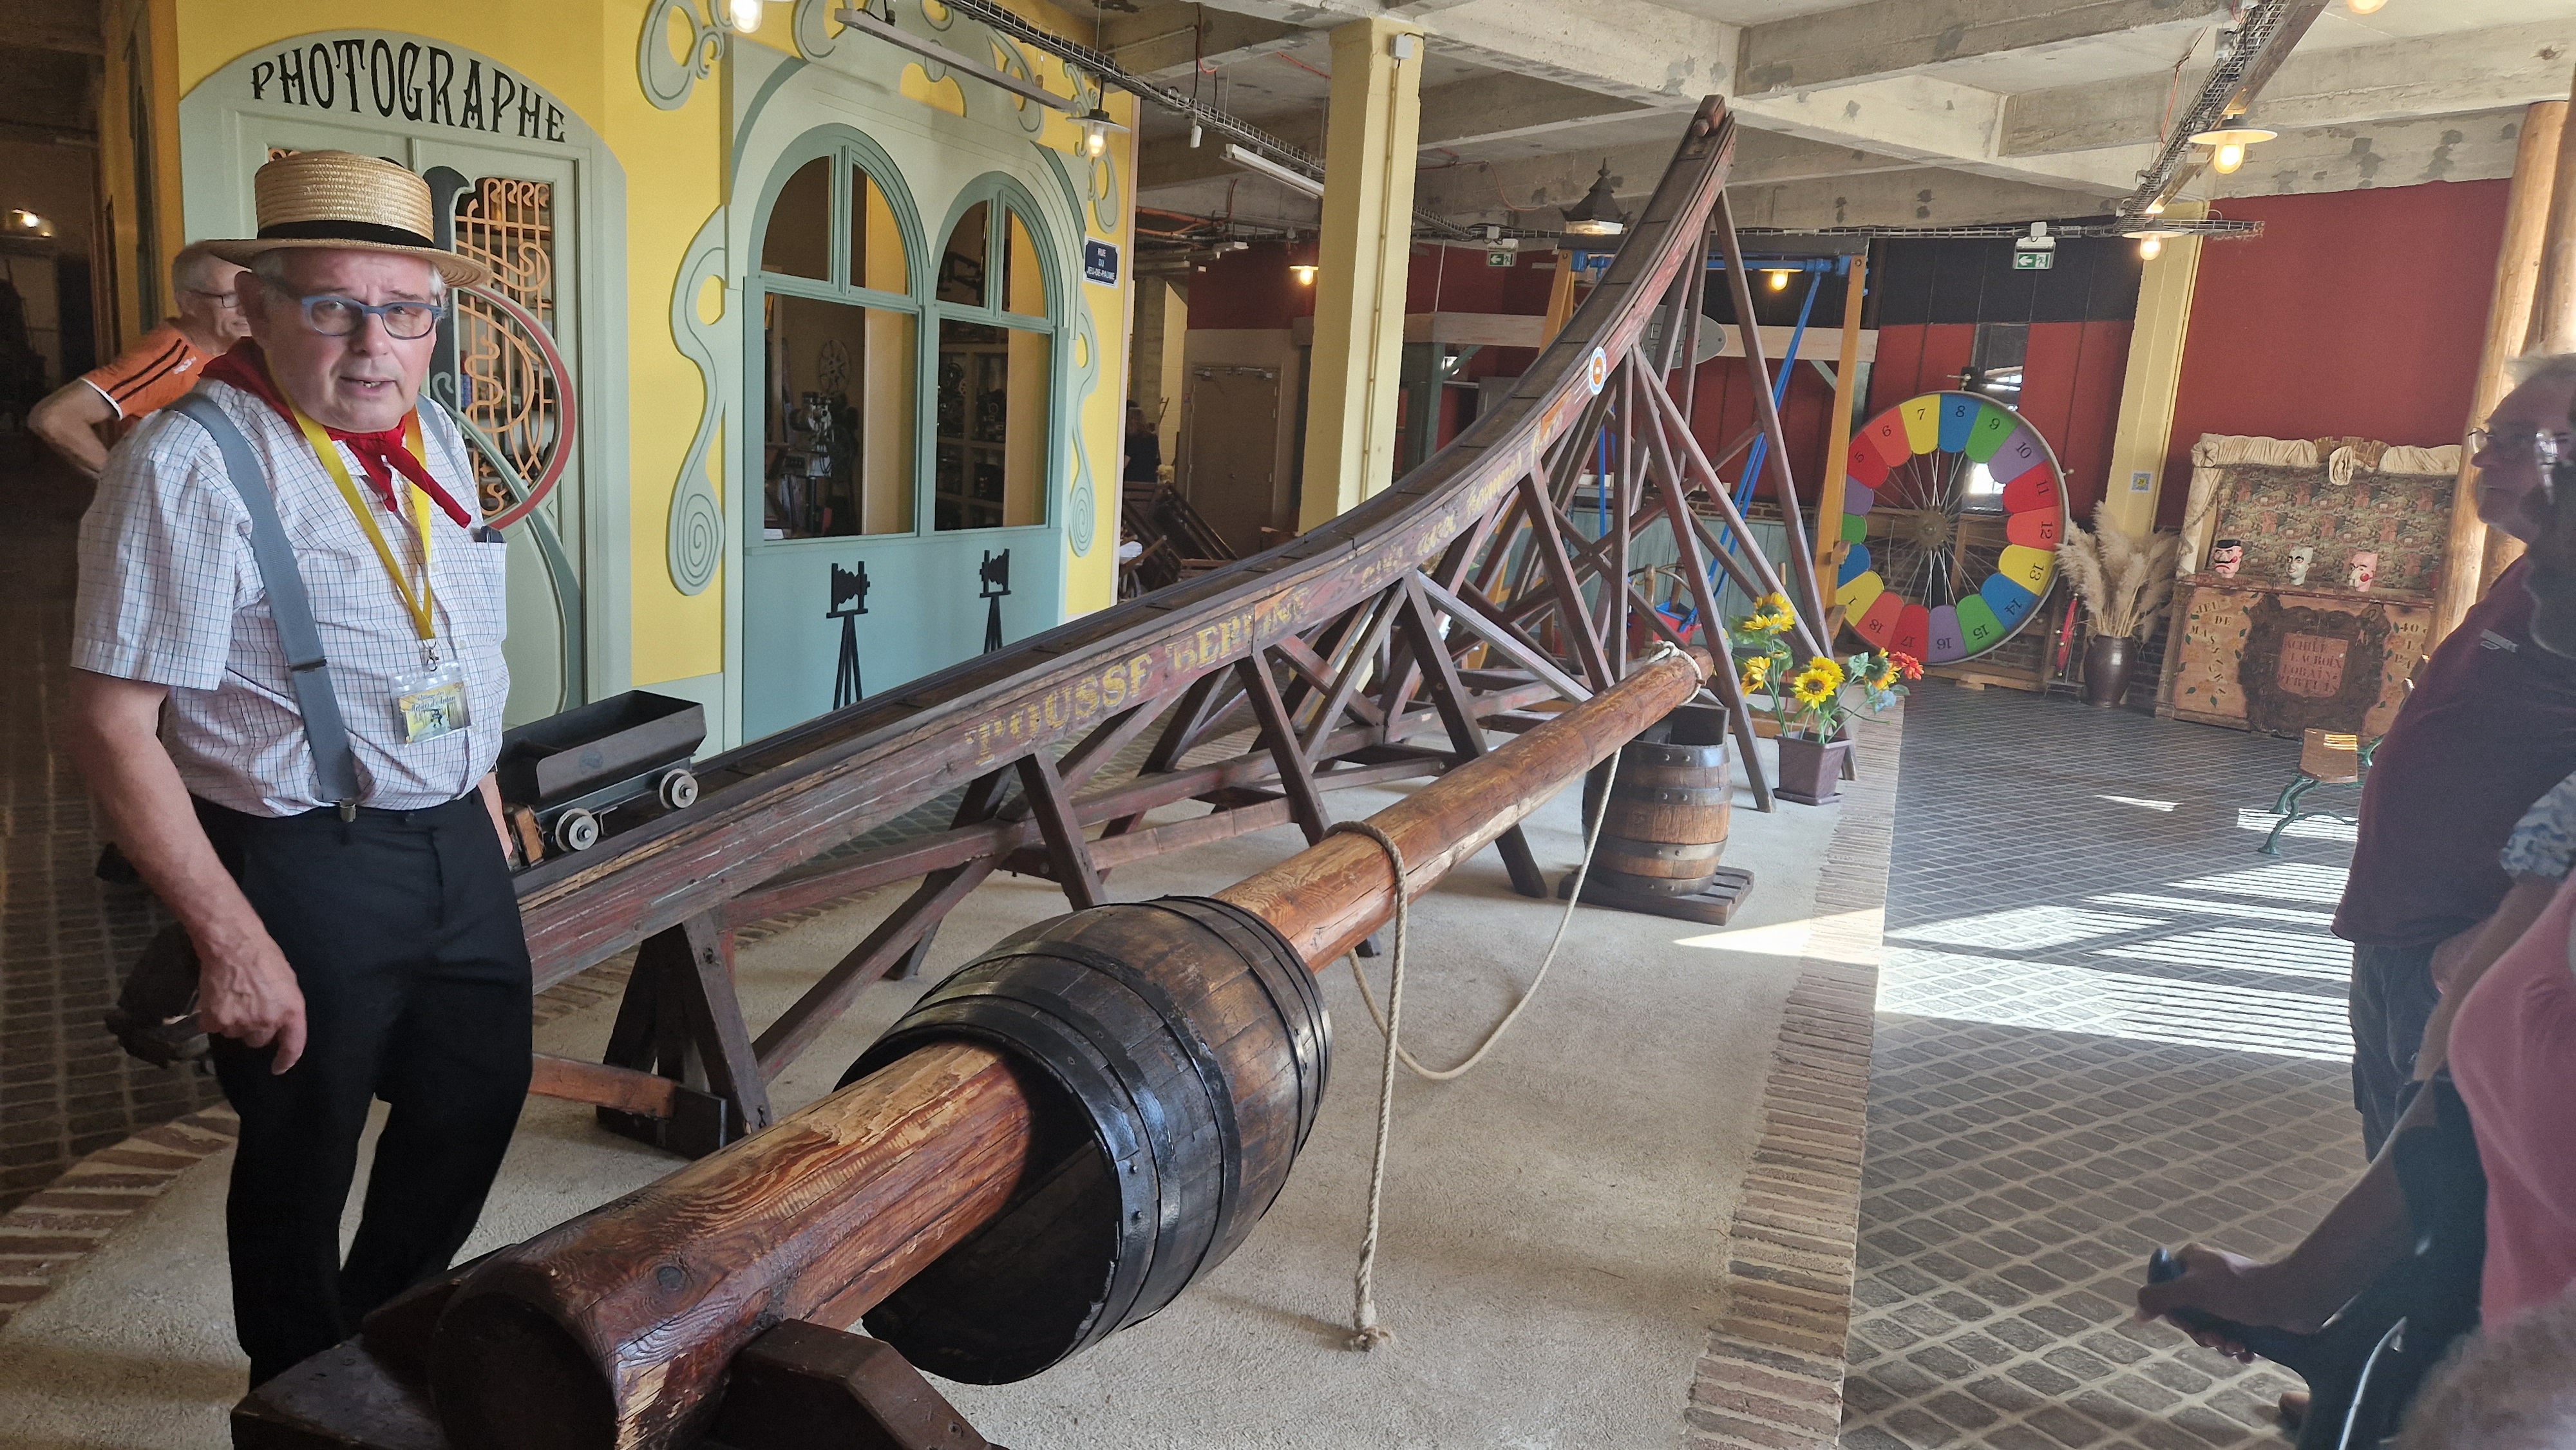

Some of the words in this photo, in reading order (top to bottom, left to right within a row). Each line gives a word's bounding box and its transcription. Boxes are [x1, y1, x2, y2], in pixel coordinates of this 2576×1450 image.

[251, 38, 566, 143] PHOTOGRAPHE
[1097, 247, 1106, 257] RUE
[1098, 258, 1105, 267] DU
[1917, 408, 1926, 420] 7
[1955, 405, 1965, 418] 8
[1989, 418, 2000, 430] 9
[1882, 425, 1892, 437] 6
[2016, 442, 2032, 458] 10
[1853, 451, 1865, 463] 5
[2036, 480, 2050, 496] 11
[2040, 522, 2054, 540] 12
[2029, 562, 2045, 581] 13
[1848, 595, 1858, 606] 1
[2004, 598, 2022, 616] 14
[1868, 619, 1884, 634] 18
[2214, 615, 2232, 626] DE
[1973, 624, 1990, 640] 15
[2400, 623, 2420, 632] 40
[1900, 636, 1915, 648] 17
[1937, 637, 1952, 650] 16
